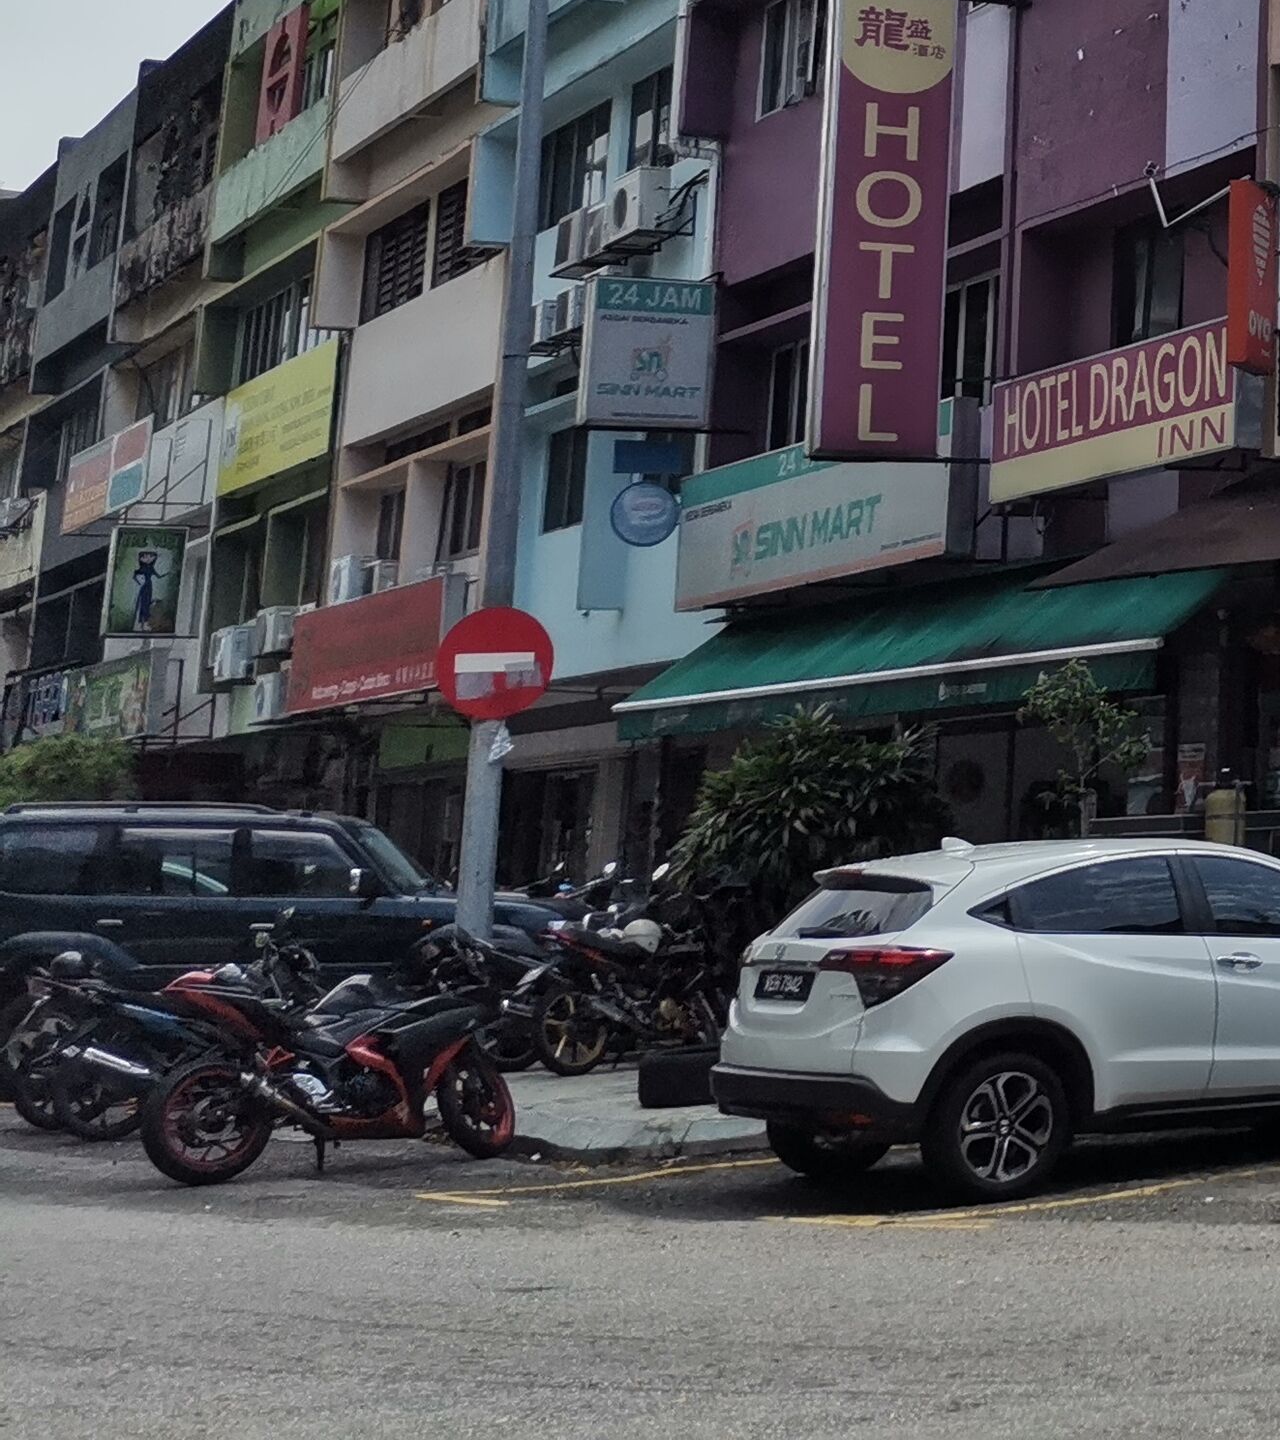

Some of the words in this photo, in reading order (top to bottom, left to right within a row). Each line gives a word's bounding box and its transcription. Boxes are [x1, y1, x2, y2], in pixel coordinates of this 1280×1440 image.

[607, 282, 640, 305] 24
[644, 285, 702, 308] JAM
[855, 102, 922, 443] HOTEL
[644, 384, 701, 399] MART
[1003, 368, 1084, 456] HOTEL
[1089, 326, 1227, 433] DRAGON
[1157, 411, 1226, 458] INN
[776, 452, 797, 477] 24
[754, 512, 807, 561] SINN
[808, 492, 883, 548] MART
